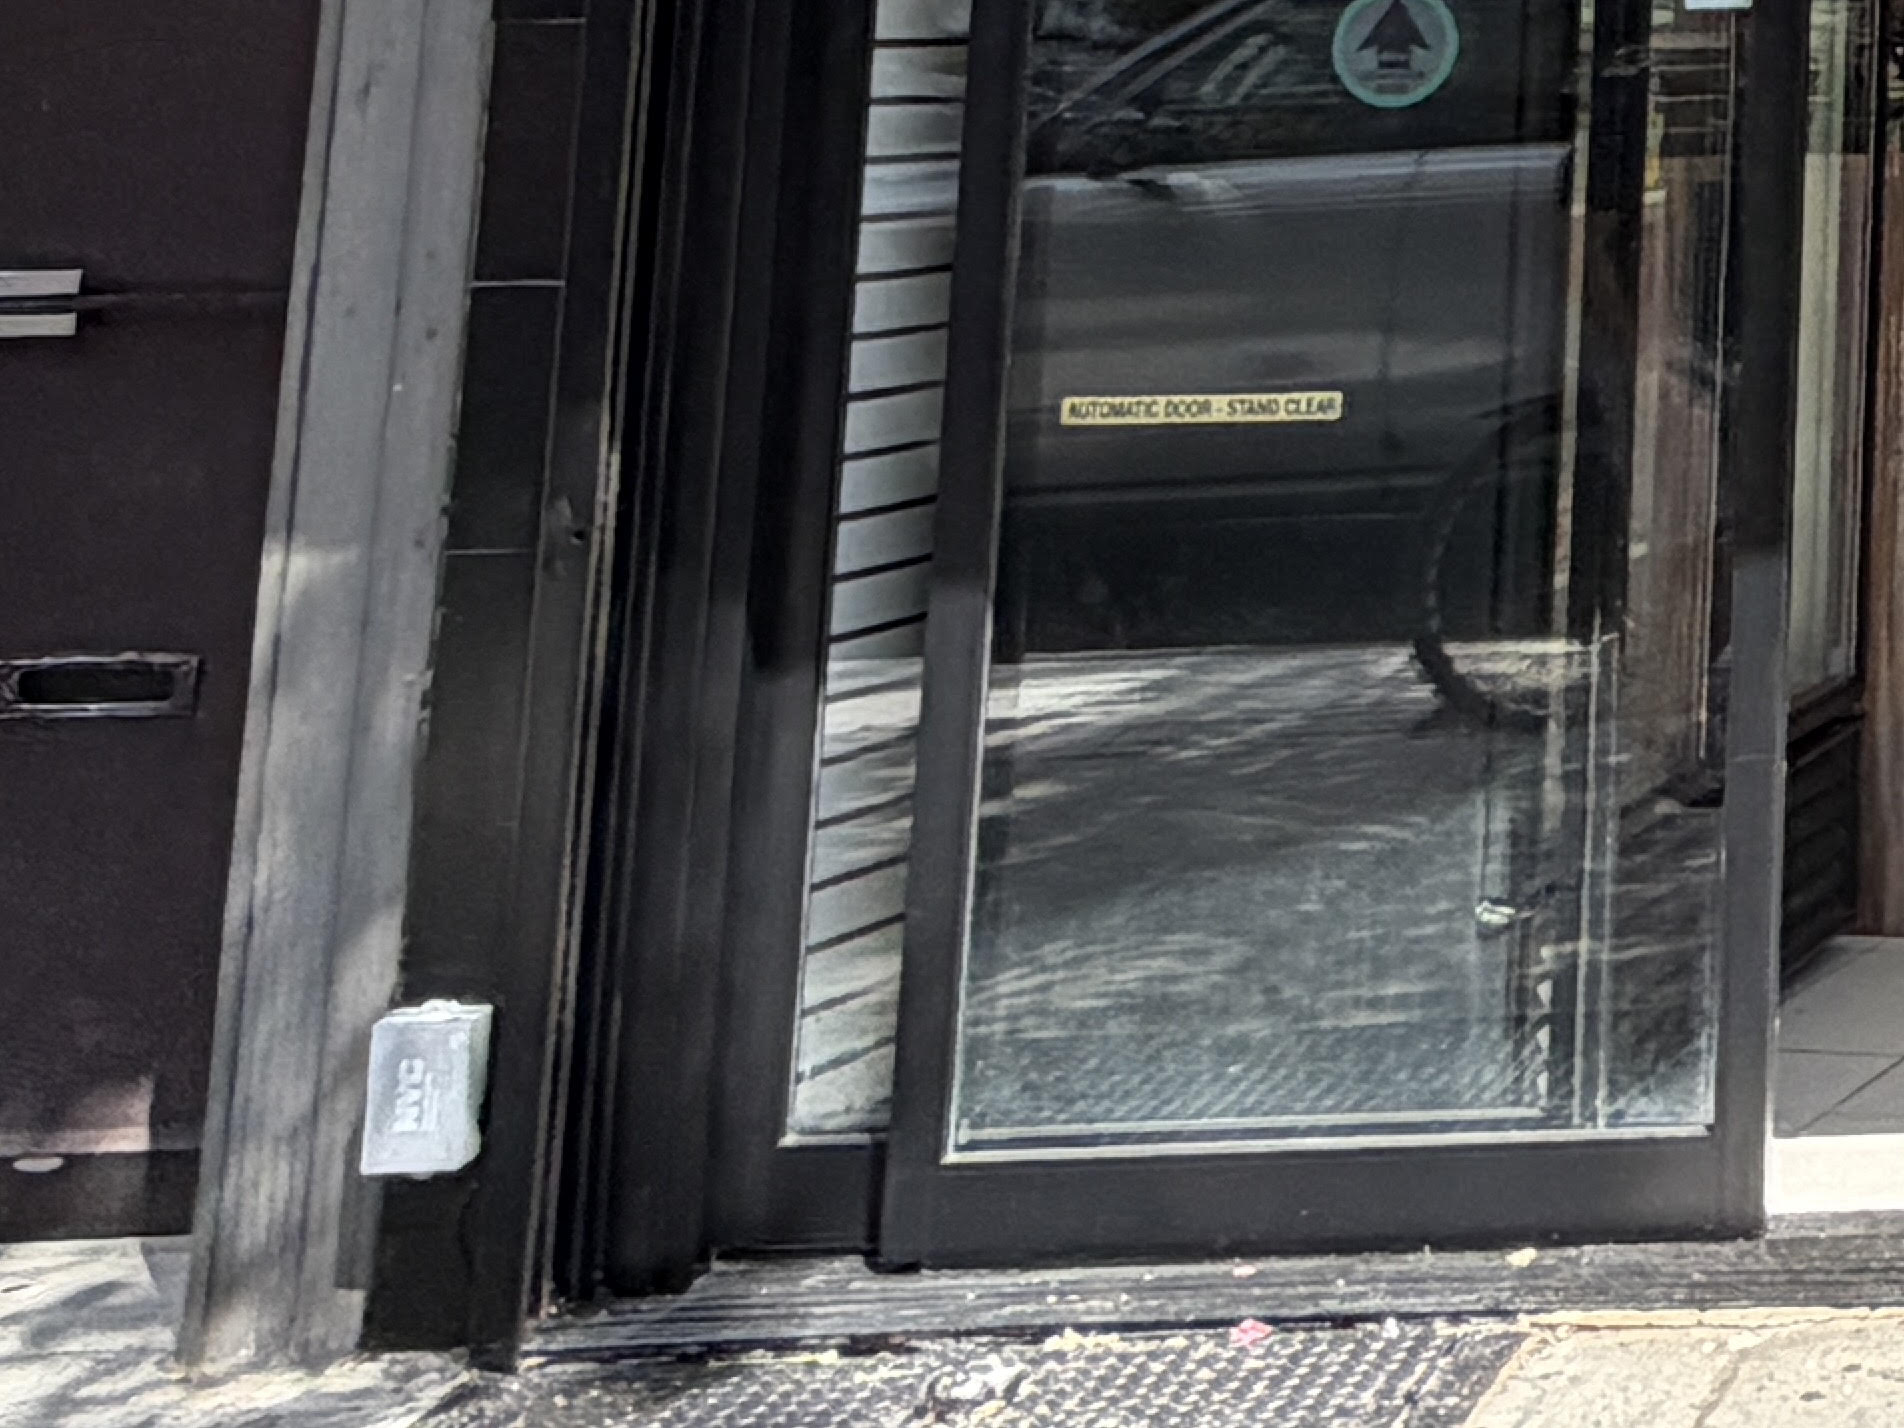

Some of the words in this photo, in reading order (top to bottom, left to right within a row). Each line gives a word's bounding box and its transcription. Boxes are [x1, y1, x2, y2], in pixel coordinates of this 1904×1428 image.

[1068, 400, 1160, 419] AUTOMATIC
[1164, 399, 1212, 418] DOOR
[1226, 398, 1280, 417] STAND
[1284, 396, 1337, 415] CLEAR
